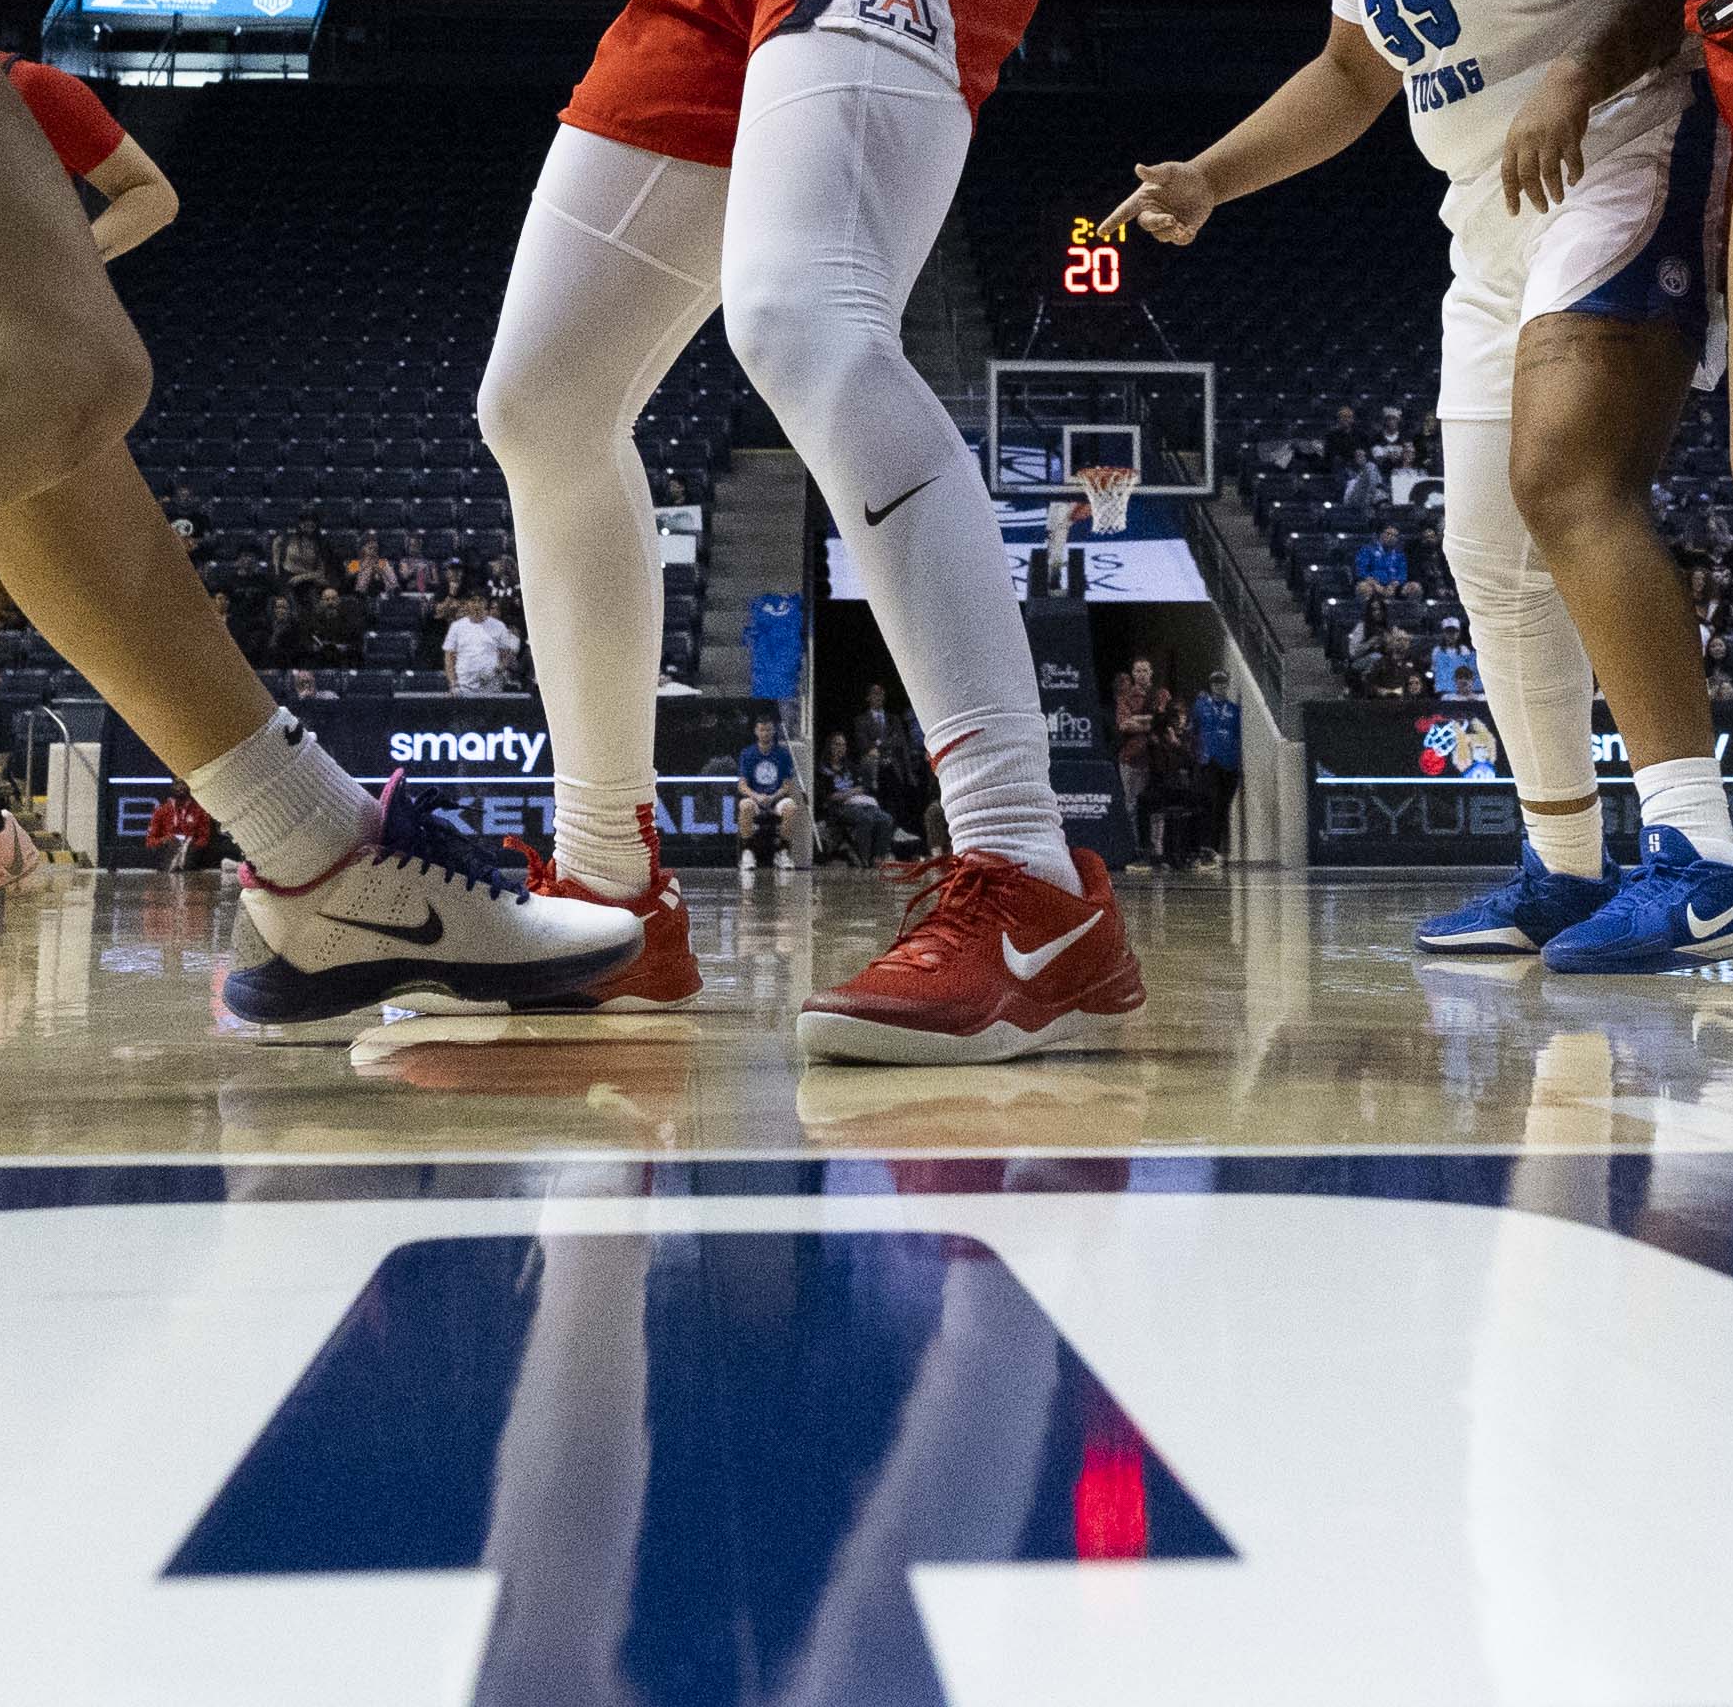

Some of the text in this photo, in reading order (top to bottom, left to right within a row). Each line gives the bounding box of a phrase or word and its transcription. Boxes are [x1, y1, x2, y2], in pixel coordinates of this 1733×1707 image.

[1409, 56, 1486, 116] YOUNG
[1071, 217, 1127, 244] 2:1
[1064, 246, 1120, 293] 20
[390, 725, 546, 773] smarty
[1590, 732, 1731, 762] smy
